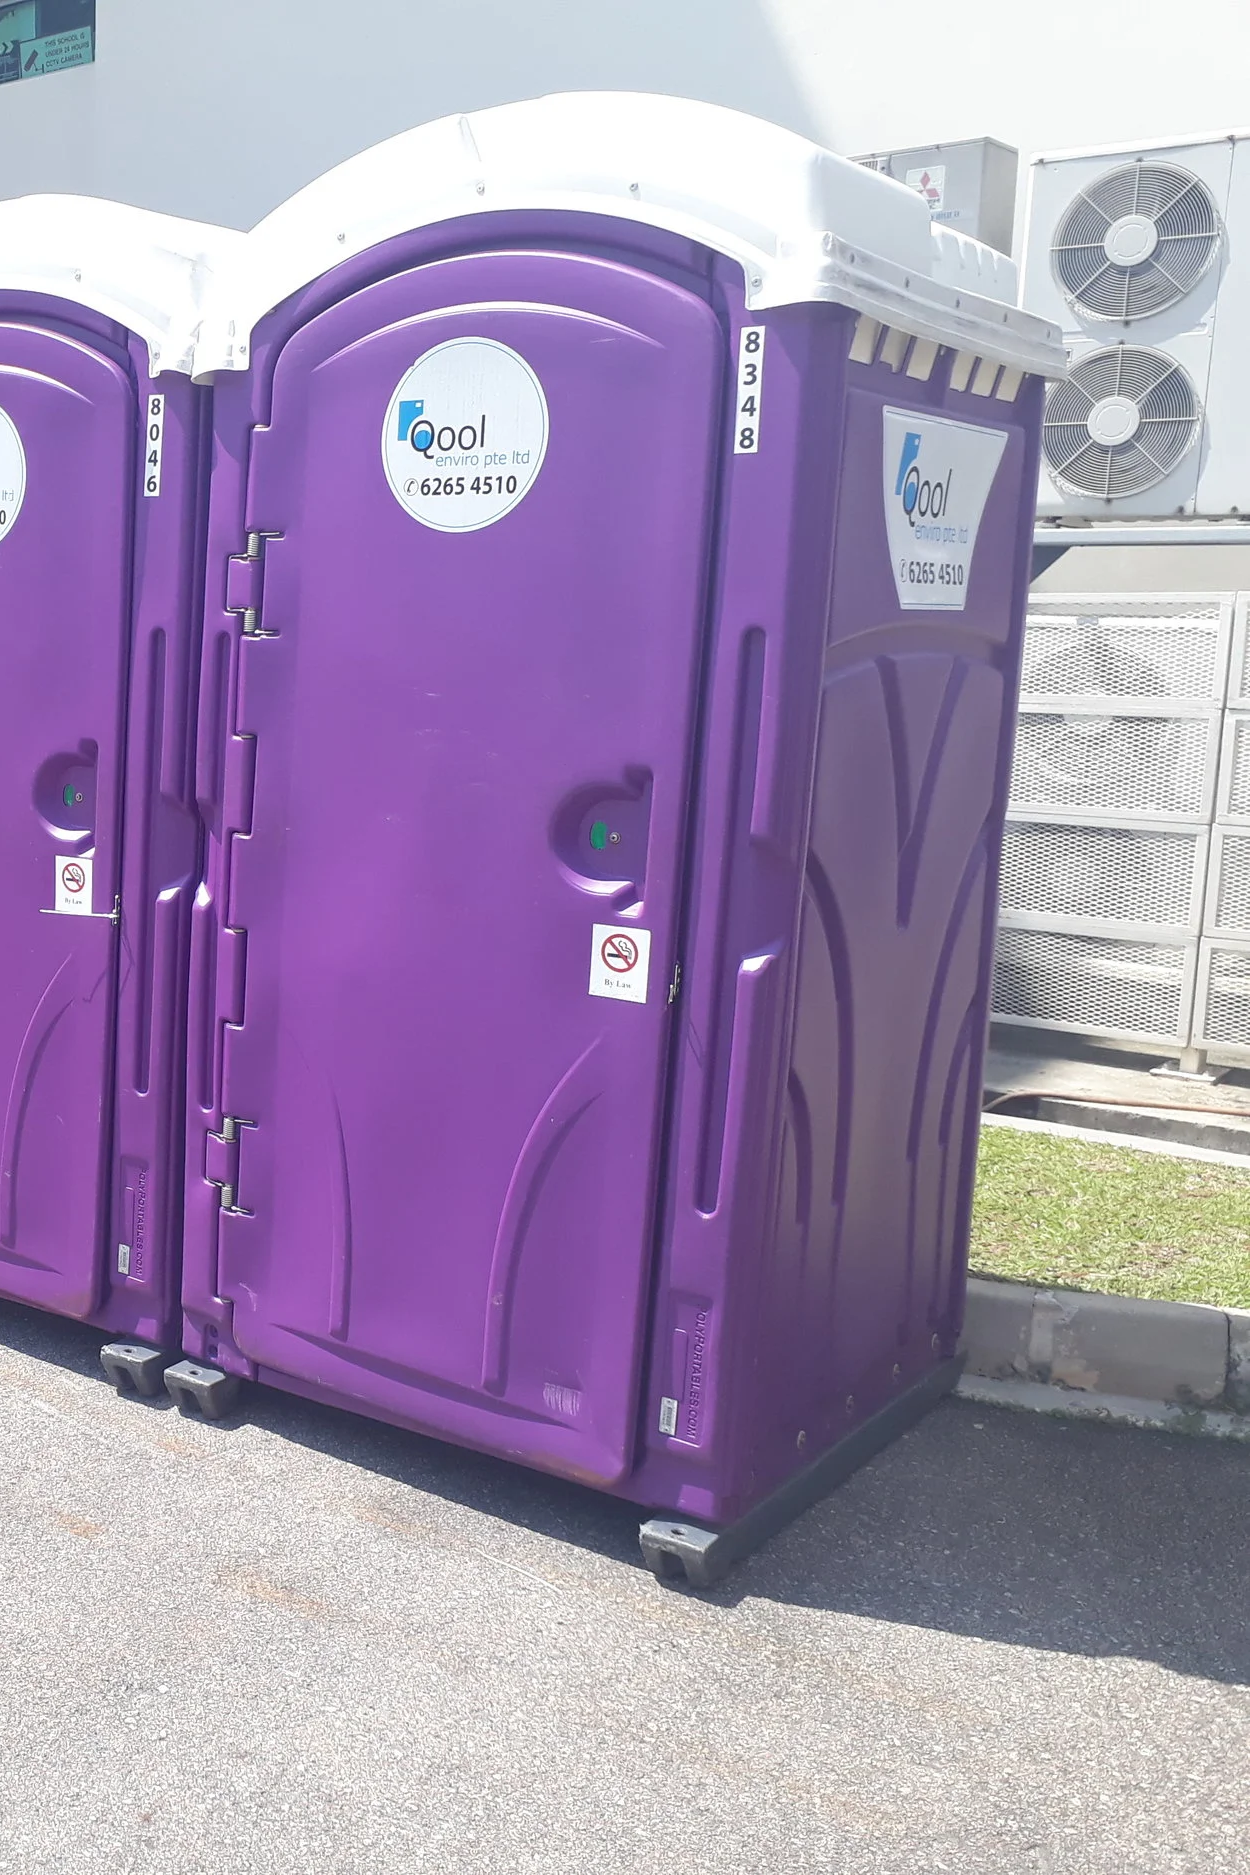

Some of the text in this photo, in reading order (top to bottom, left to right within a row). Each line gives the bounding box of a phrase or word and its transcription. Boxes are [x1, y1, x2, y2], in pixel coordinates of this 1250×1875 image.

[57, 34, 78, 45] SCHOOL
[45, 53, 82, 67] CCTV CAMERA
[738, 331, 761, 450] 8348
[146, 398, 161, 493] 8046
[410, 414, 486, 459] Qool
[435, 450, 530, 470] enviro pte ltd
[420, 475, 517, 496] 6265 4510
[903, 466, 952, 527] Qool
[915, 524, 940, 542] enviro
[908, 561, 964, 586] 6265 4510
[604, 979, 632, 989] By Law
